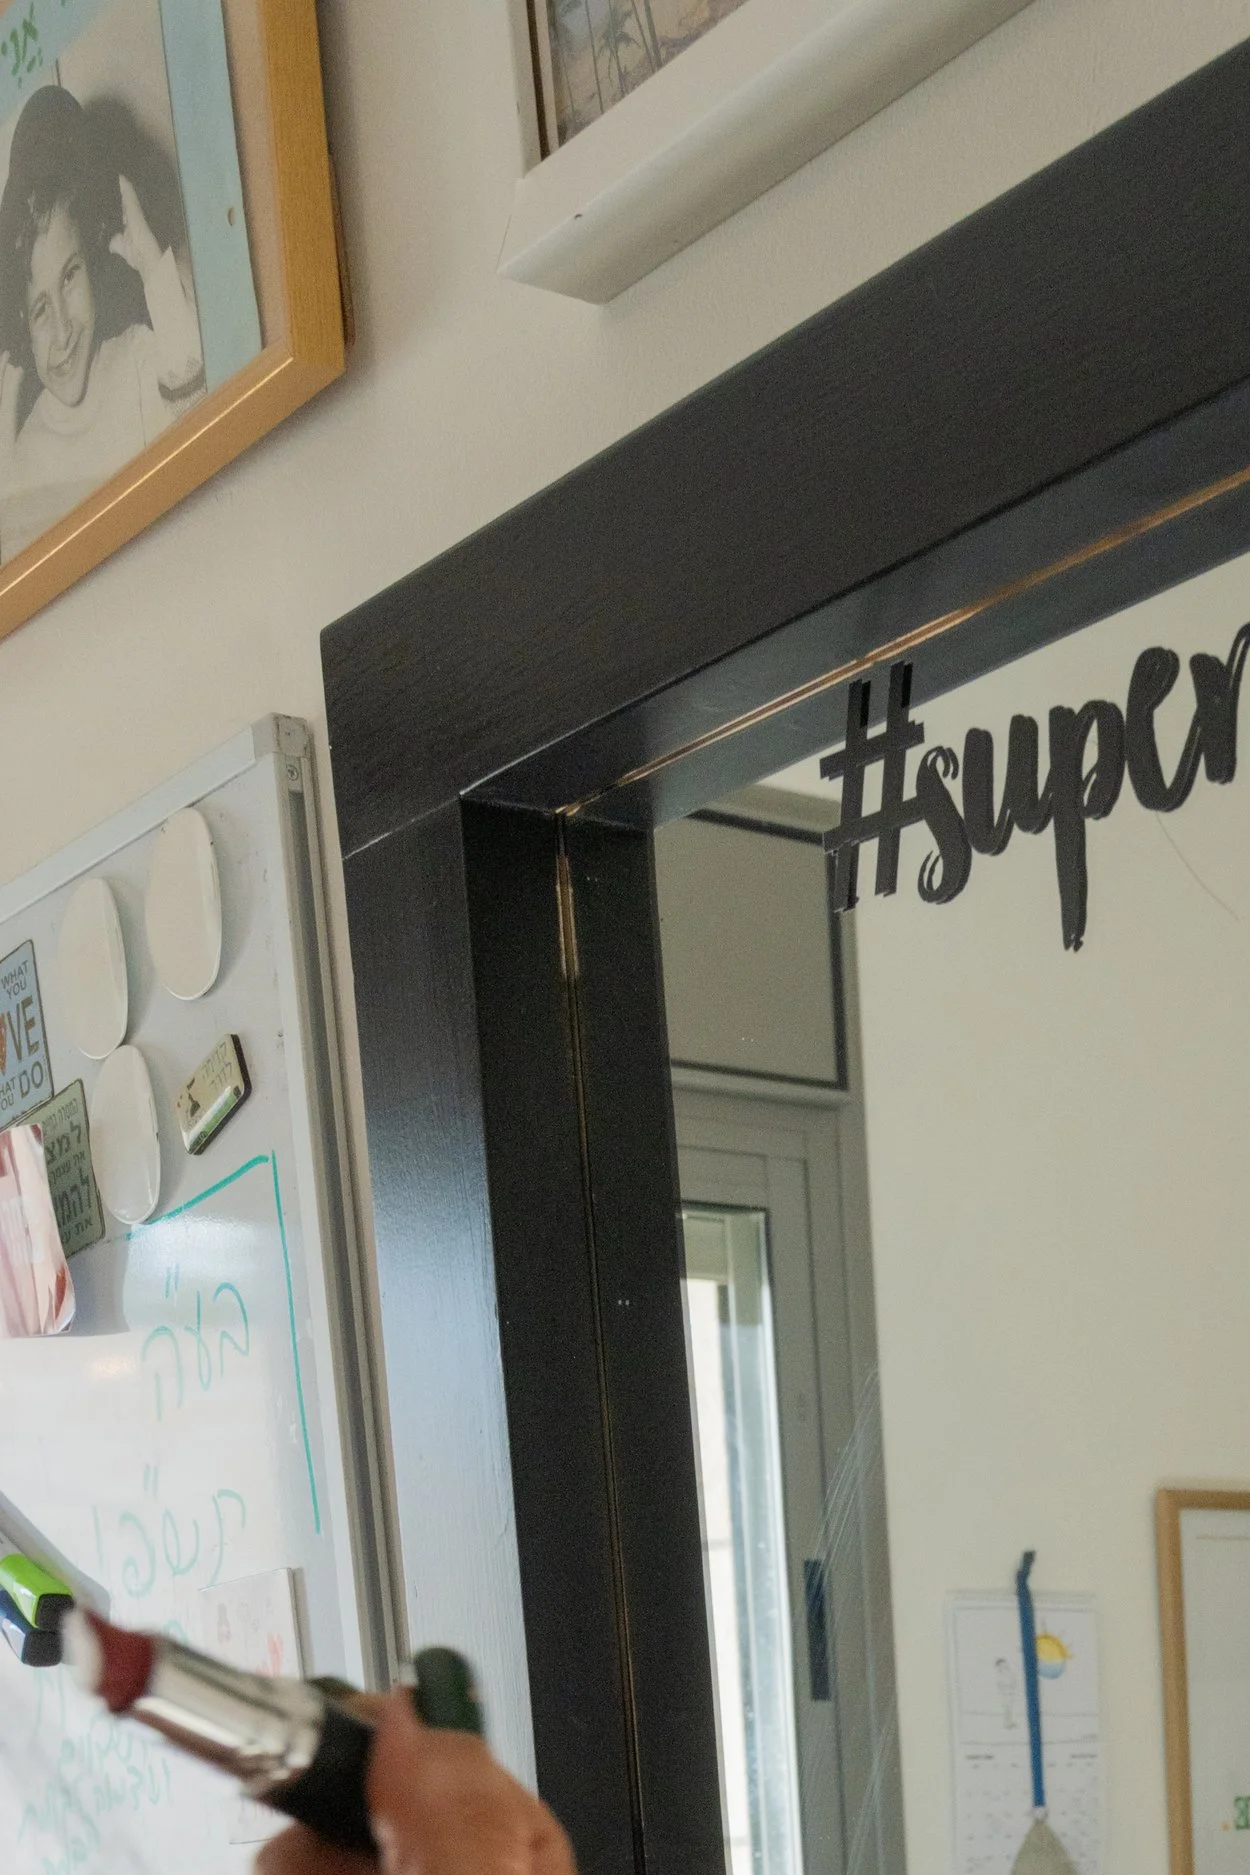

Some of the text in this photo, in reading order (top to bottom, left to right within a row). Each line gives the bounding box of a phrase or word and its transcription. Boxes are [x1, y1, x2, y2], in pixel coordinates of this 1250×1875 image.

[0, 960, 29, 989] WHAT
[6, 977, 27, 999] YOU
[7, 995, 39, 1060] VE
[0, 1061, 43, 1098] HAT DO
[0, 1093, 15, 1111] OU
[46, 1120, 82, 1165] למצ
[73, 1150, 86, 1163] את
[74, 1216, 93, 1236] את
